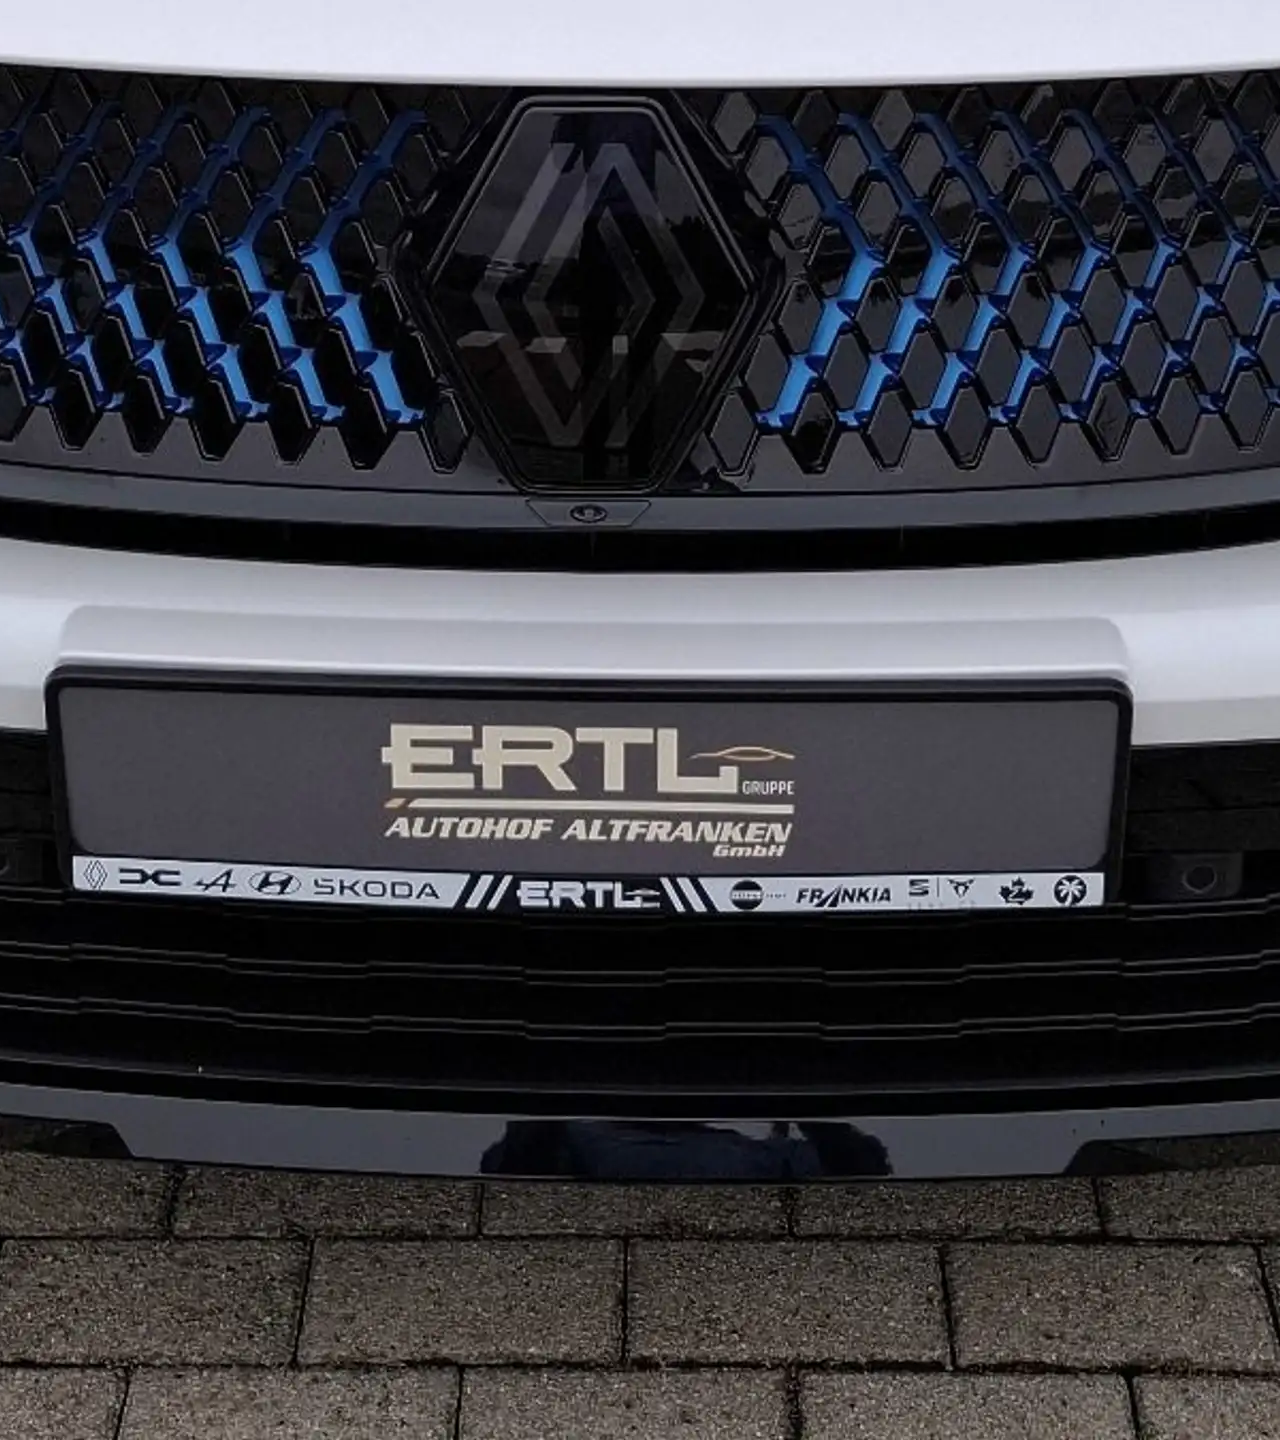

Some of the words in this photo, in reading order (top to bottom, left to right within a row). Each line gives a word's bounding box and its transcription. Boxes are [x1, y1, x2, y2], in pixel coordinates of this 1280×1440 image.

[382, 723, 738, 794] ERTL
[742, 780, 795, 796] GRUPPE
[384, 817, 554, 840] AUTOHOF
[560, 818, 793, 843] ALTFRANKEN
[712, 844, 786, 858] GmbH
[516, 880, 642, 908] ERTL
[796, 884, 891, 908] FRANKIA
